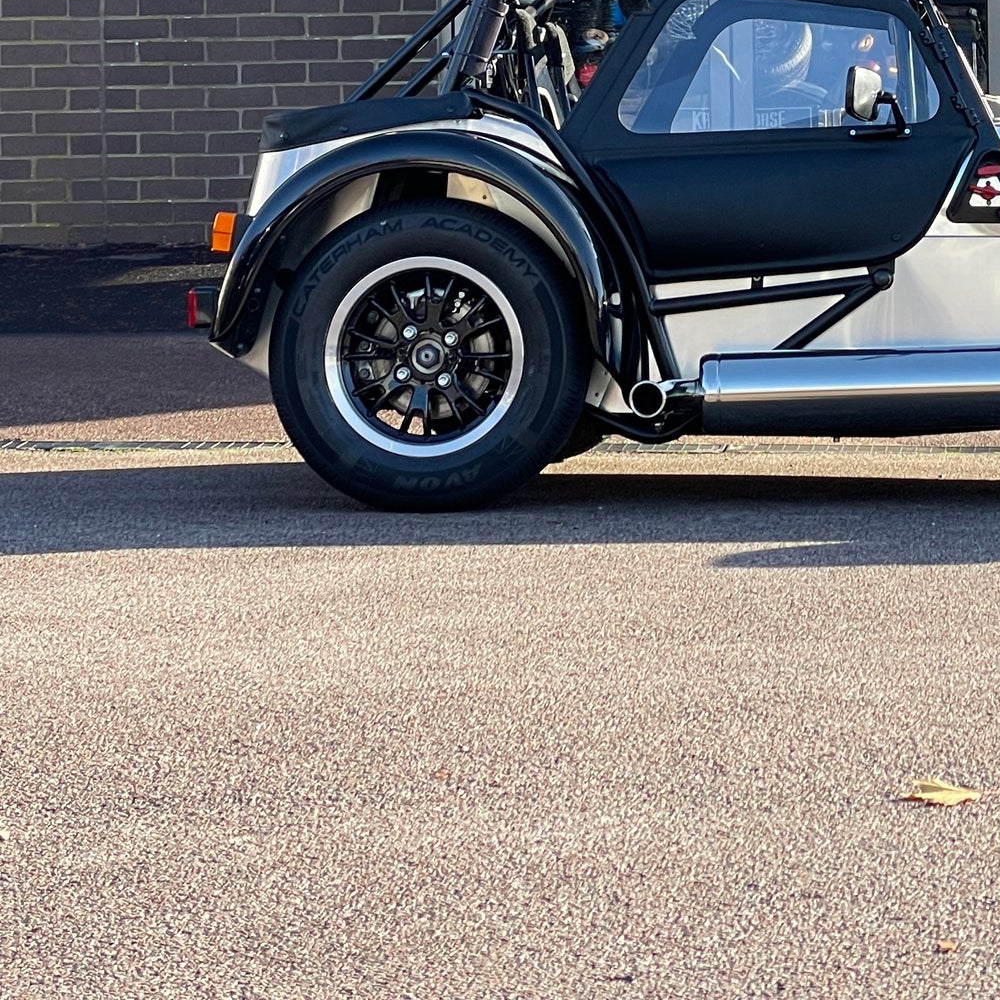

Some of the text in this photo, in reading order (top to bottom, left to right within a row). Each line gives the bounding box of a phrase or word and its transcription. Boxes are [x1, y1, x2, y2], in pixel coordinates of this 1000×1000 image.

[290, 216, 540, 318] CATERHAM ACADEMY
[391, 464, 482, 491] AVON
